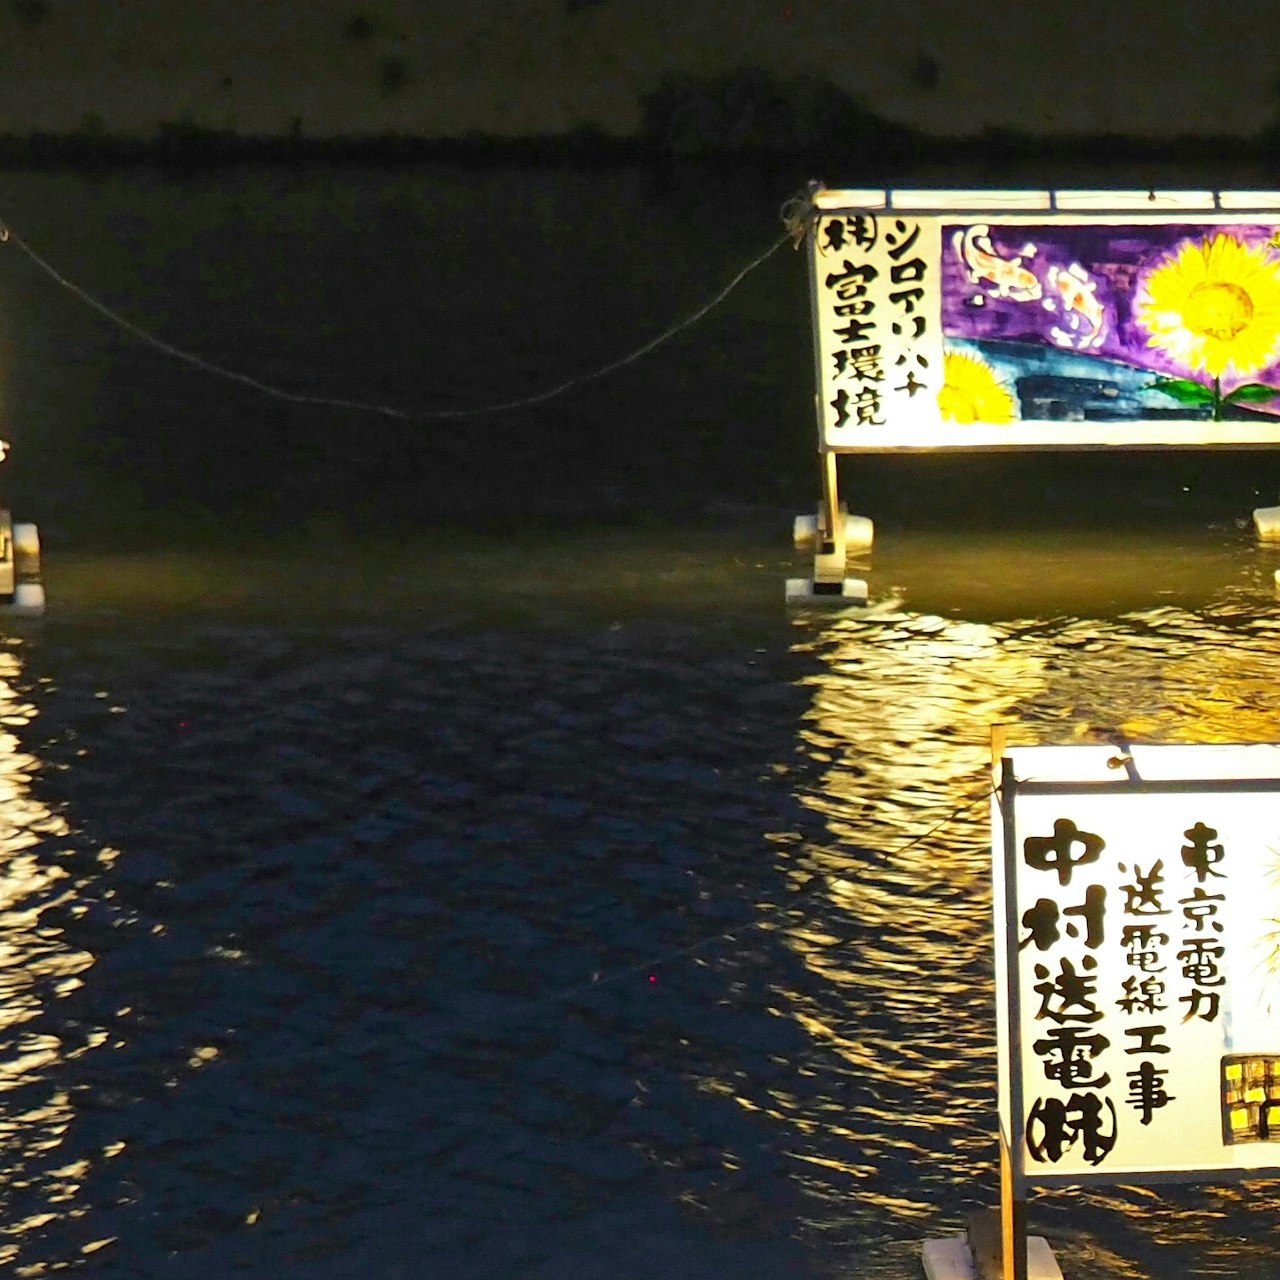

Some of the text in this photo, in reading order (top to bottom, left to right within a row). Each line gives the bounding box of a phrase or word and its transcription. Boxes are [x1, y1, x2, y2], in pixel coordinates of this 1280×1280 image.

[816, 212, 887, 428] (株)富士環境
[1018, 818, 1118, 1167] 中村送電(株)
[1115, 859, 1177, 1126] 送電線工事
[1177, 822, 1229, 1025] 東京電力
